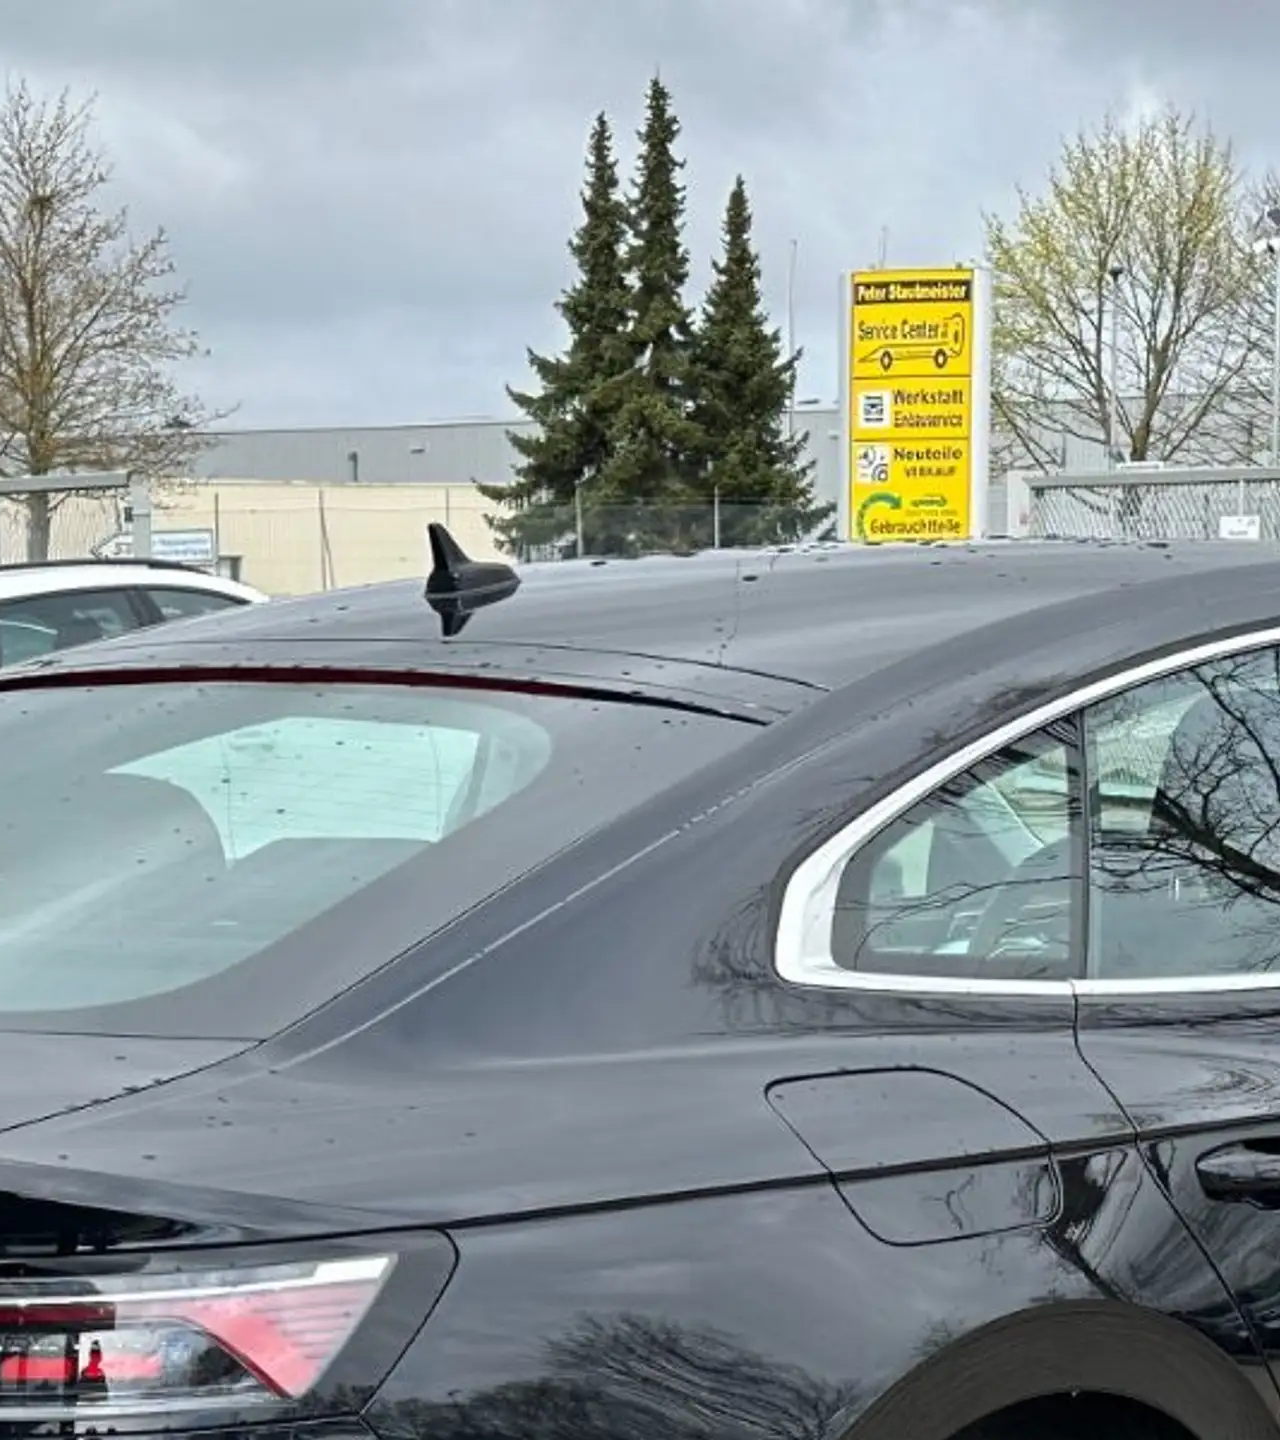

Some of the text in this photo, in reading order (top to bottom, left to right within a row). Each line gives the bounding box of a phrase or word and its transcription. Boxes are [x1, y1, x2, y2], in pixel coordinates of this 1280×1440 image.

[858, 319, 939, 341] Service Center
[893, 389, 964, 405] Werkstatt
[894, 447, 962, 460] Neuteile
